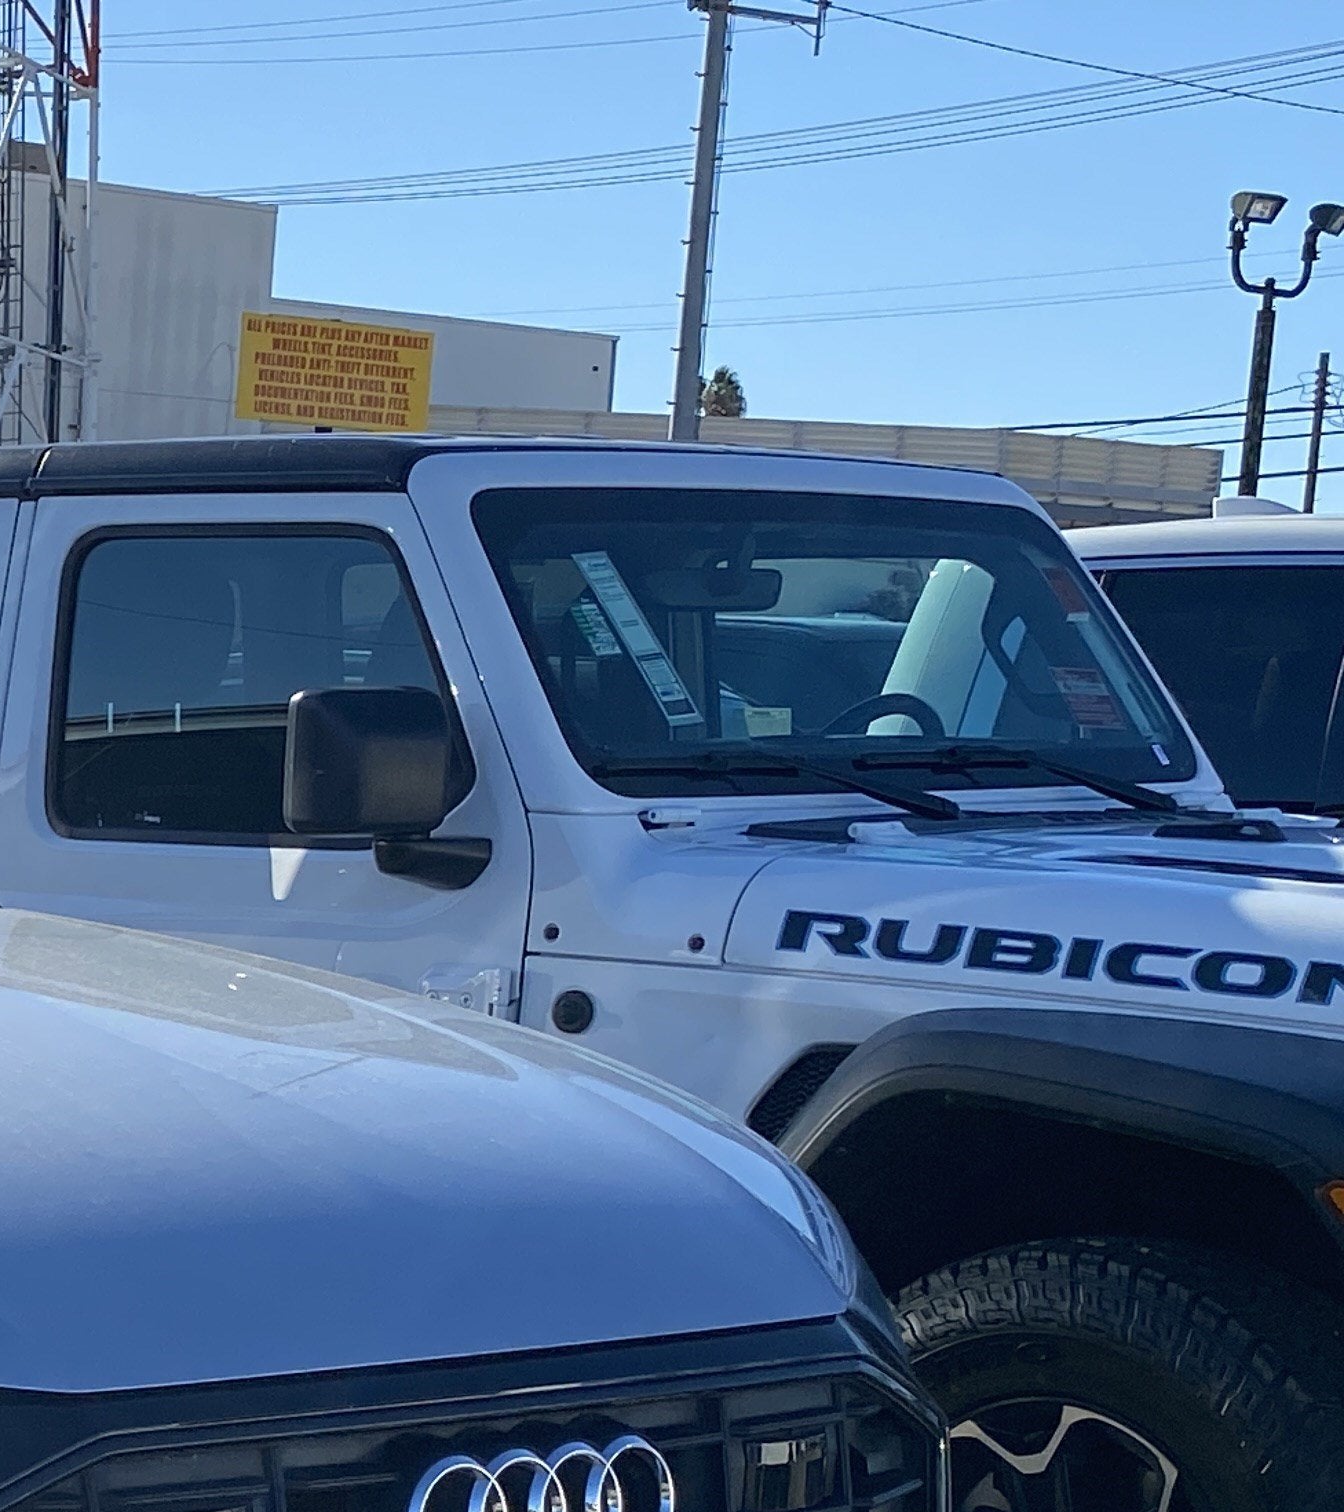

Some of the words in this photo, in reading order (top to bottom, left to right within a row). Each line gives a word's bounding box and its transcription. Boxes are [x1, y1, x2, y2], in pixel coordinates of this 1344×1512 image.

[246, 318, 262, 332] ALL
[264, 320, 297, 336] PRICES
[299, 323, 317, 338] ARE
[319, 325, 342, 341] PLUS
[344, 328, 362, 343] ANY
[363, 330, 391, 345] AFTER
[391, 333, 429, 350] MARKET
[253, 383, 331, 402] DOCUMENTATION
[295, 404, 315, 417] AND
[317, 405, 383, 423] REGISTRATION
